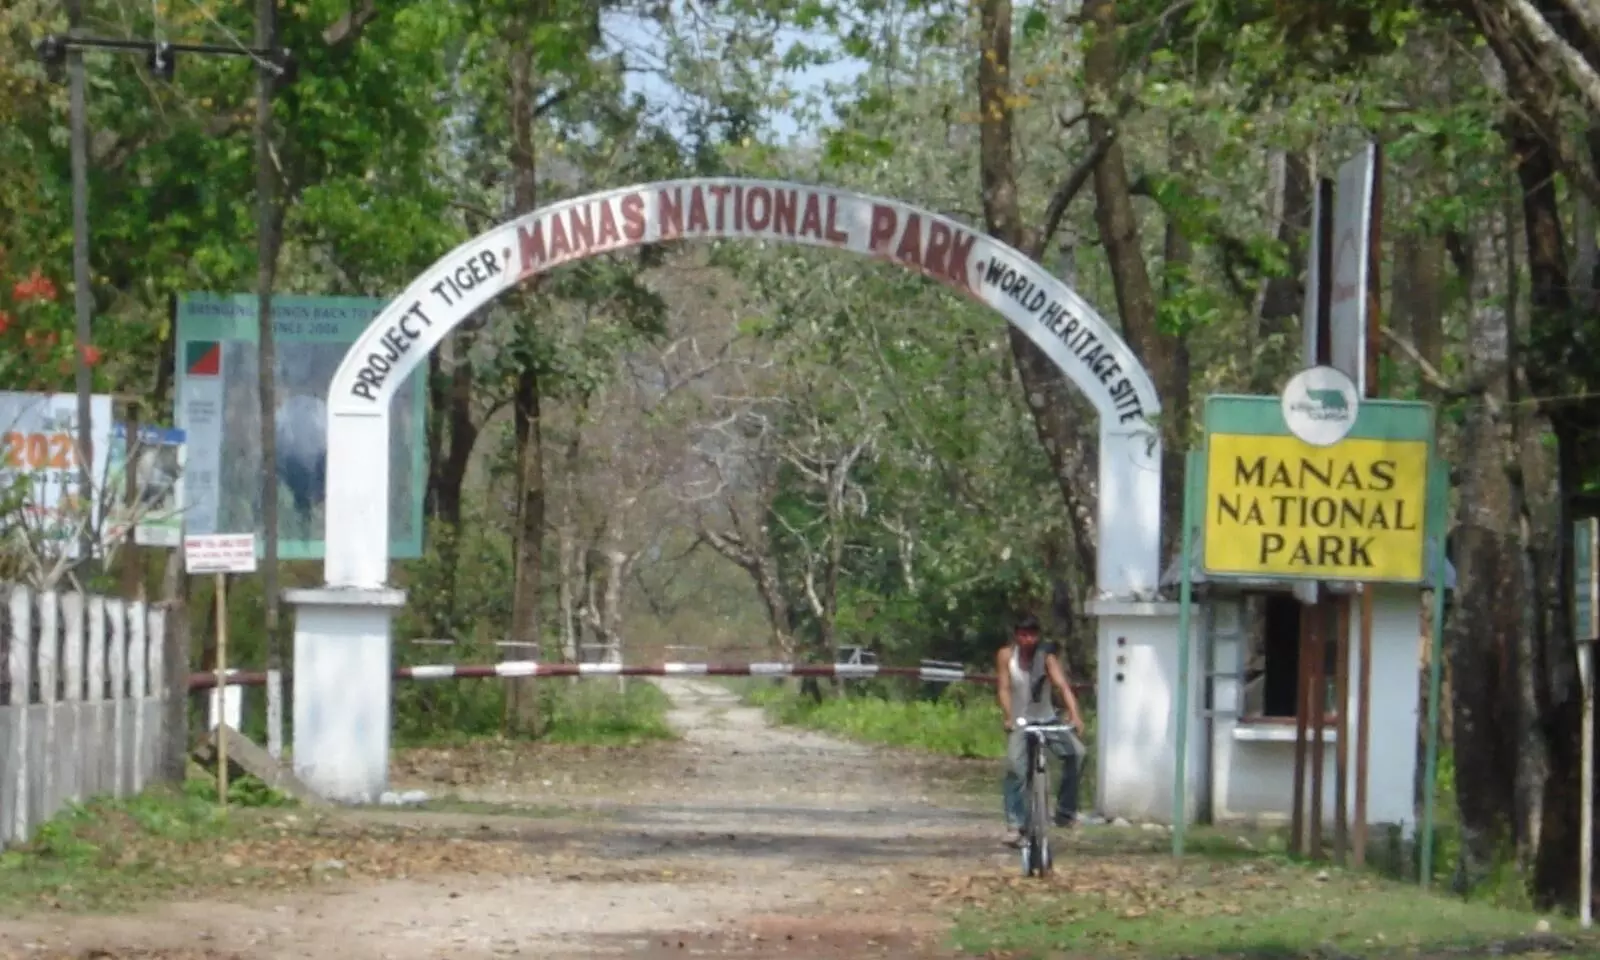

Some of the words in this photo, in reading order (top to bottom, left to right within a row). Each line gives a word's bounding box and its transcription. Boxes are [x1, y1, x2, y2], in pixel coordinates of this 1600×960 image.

[518, 192, 647, 271] MANAS
[658, 185, 848, 244] NATIONAL
[869, 204, 976, 282] PARK
[352, 300, 433, 402] PROJECT
[430, 249, 502, 307] TIGER
[985, 256, 1046, 312] WORLD
[1040, 301, 1123, 384] HERITAGE
[1109, 377, 1144, 424] SITE
[3, 431, 80, 470] 202
[1234, 456, 1397, 491] MANAS
[1217, 493, 1416, 531] NATIONAL
[1258, 532, 1375, 568] PARK
